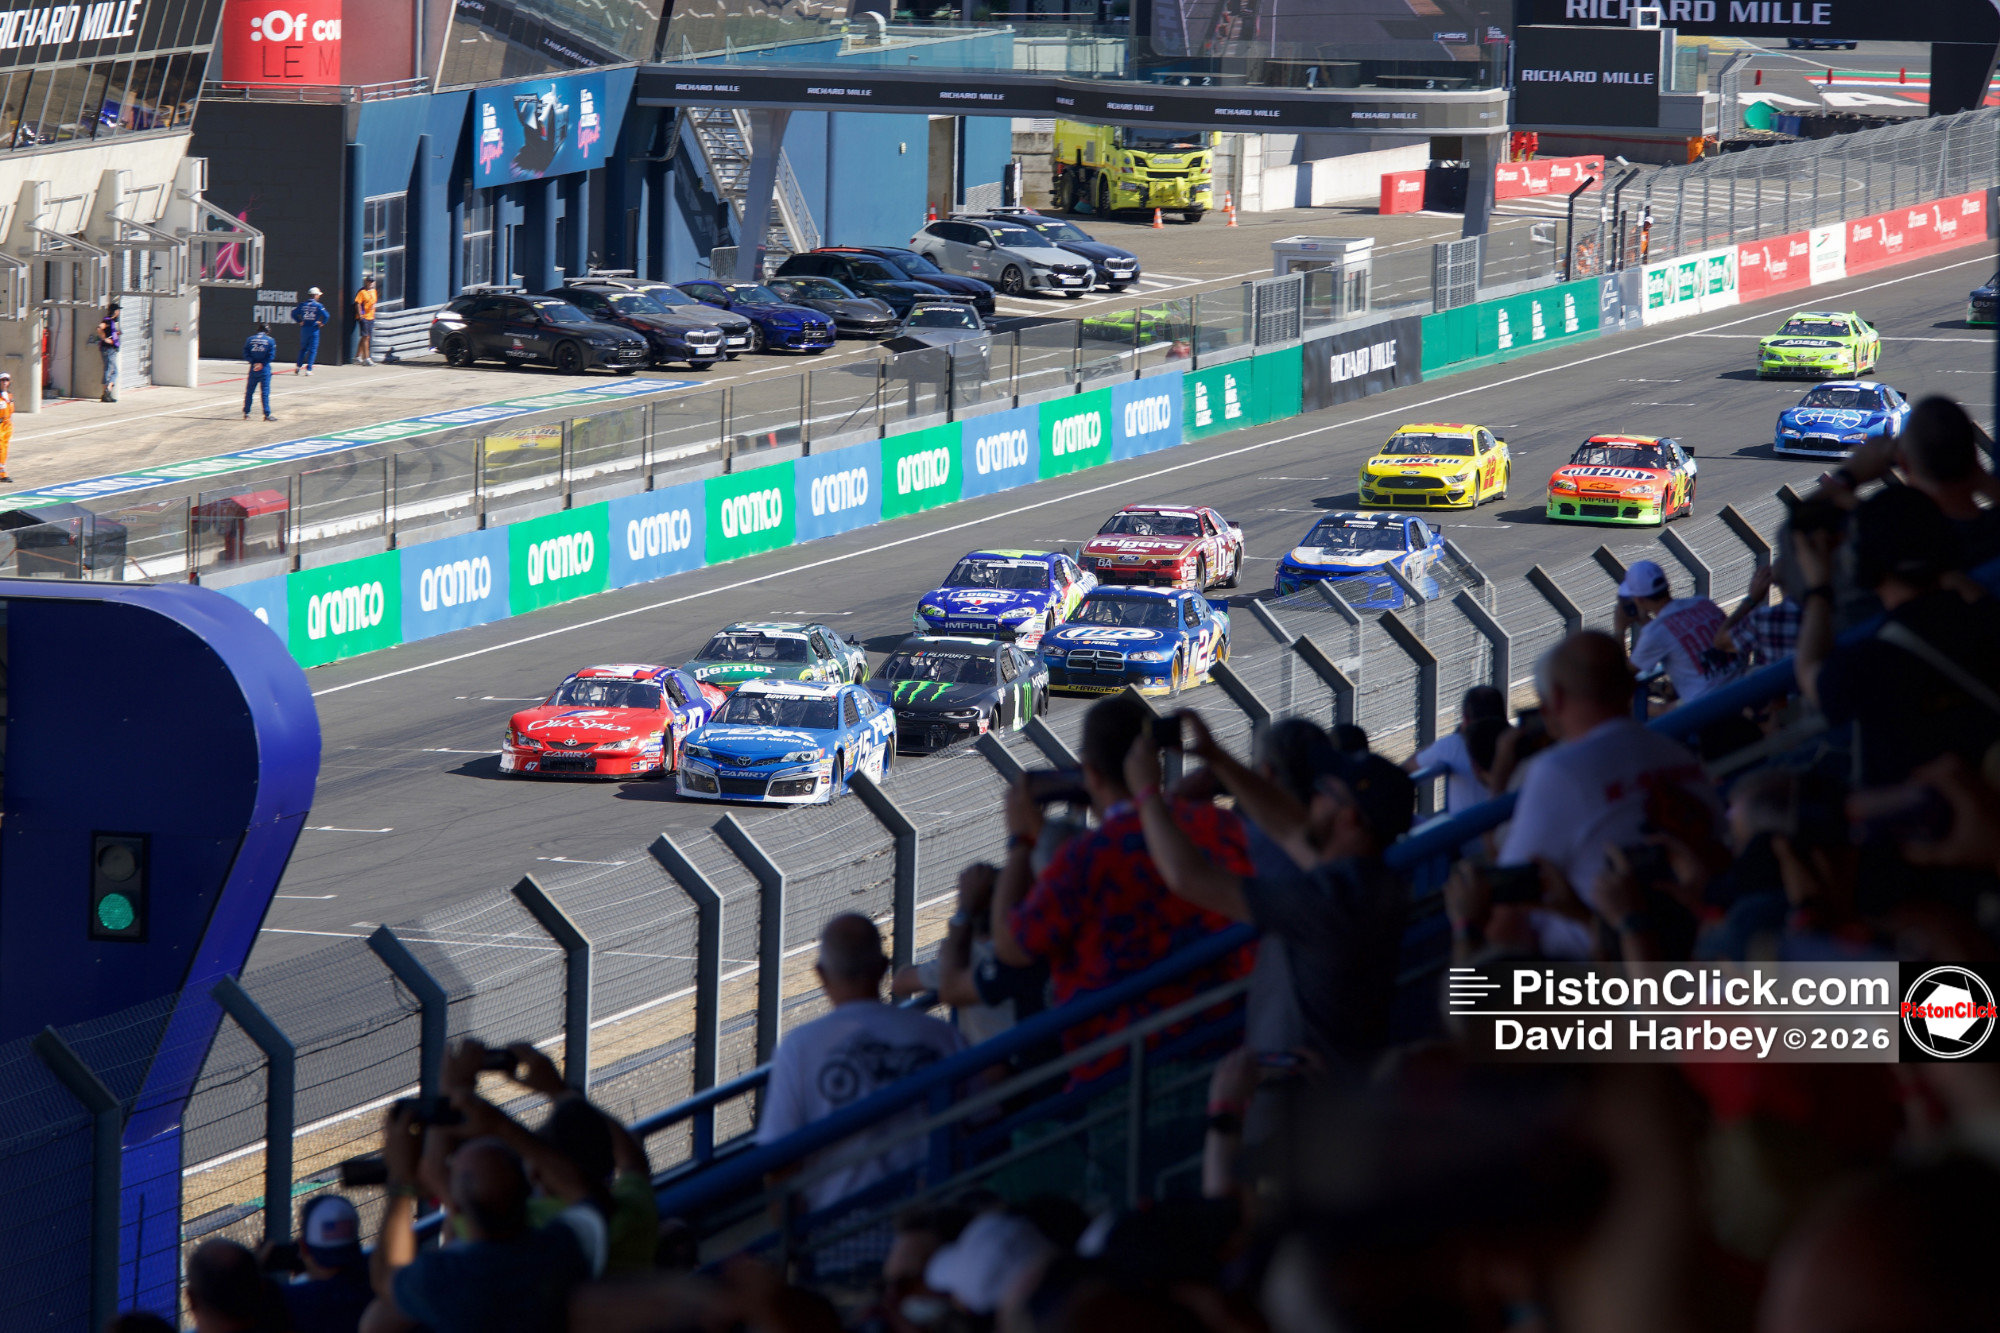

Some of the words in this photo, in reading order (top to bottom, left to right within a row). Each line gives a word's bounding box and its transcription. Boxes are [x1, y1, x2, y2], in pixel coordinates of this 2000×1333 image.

[79, 0, 141, 42] MILLE
[1729, 1, 1832, 26] MILLE
[262, 45, 304, 78] LE
[675, 83, 713, 91] RICHARD
[1425, 79, 1435, 89] 3
[1521, 69, 1597, 84] RICHARD
[1602, 72, 1654, 85] MILLE
[807, 87, 845, 95] RICHARD
[939, 91, 978, 100] RICHARD
[1214, 107, 1252, 116] RICHARD
[1254, 108, 1281, 117] MILLE
[1351, 111, 1391, 119] RICHARD
[1392, 112, 1419, 120] MILLE
[1330, 347, 1370, 384] RICHARD
[1370, 339, 1397, 372] MILLE
[1124, 394, 1171, 437] aramco
[1052, 411, 1101, 456] aramco
[976, 428, 1028, 475] aramco
[1370, 457, 1463, 466] PENNZOIL
[896, 446, 950, 495] aramco
[1483, 455, 1496, 490] 22
[810, 466, 869, 517] aramco
[721, 487, 783, 538] aramco
[627, 508, 692, 561] aramco
[1090, 539, 1184, 550] Folgers
[528, 530, 595, 586] aramco
[1097, 558, 1113, 569] 6A
[420, 555, 492, 612] aramco
[307, 581, 385, 640] aramco
[945, 621, 997, 630] IMPALA
[927, 652, 972, 660] PLAYOFFS
[1194, 628, 1211, 677] 2
[764, 693, 800, 701] BOWYER
[1067, 684, 1121, 693] CHARGER
[524, 761, 539, 771] 47
[719, 770, 768, 778] CAMRY
